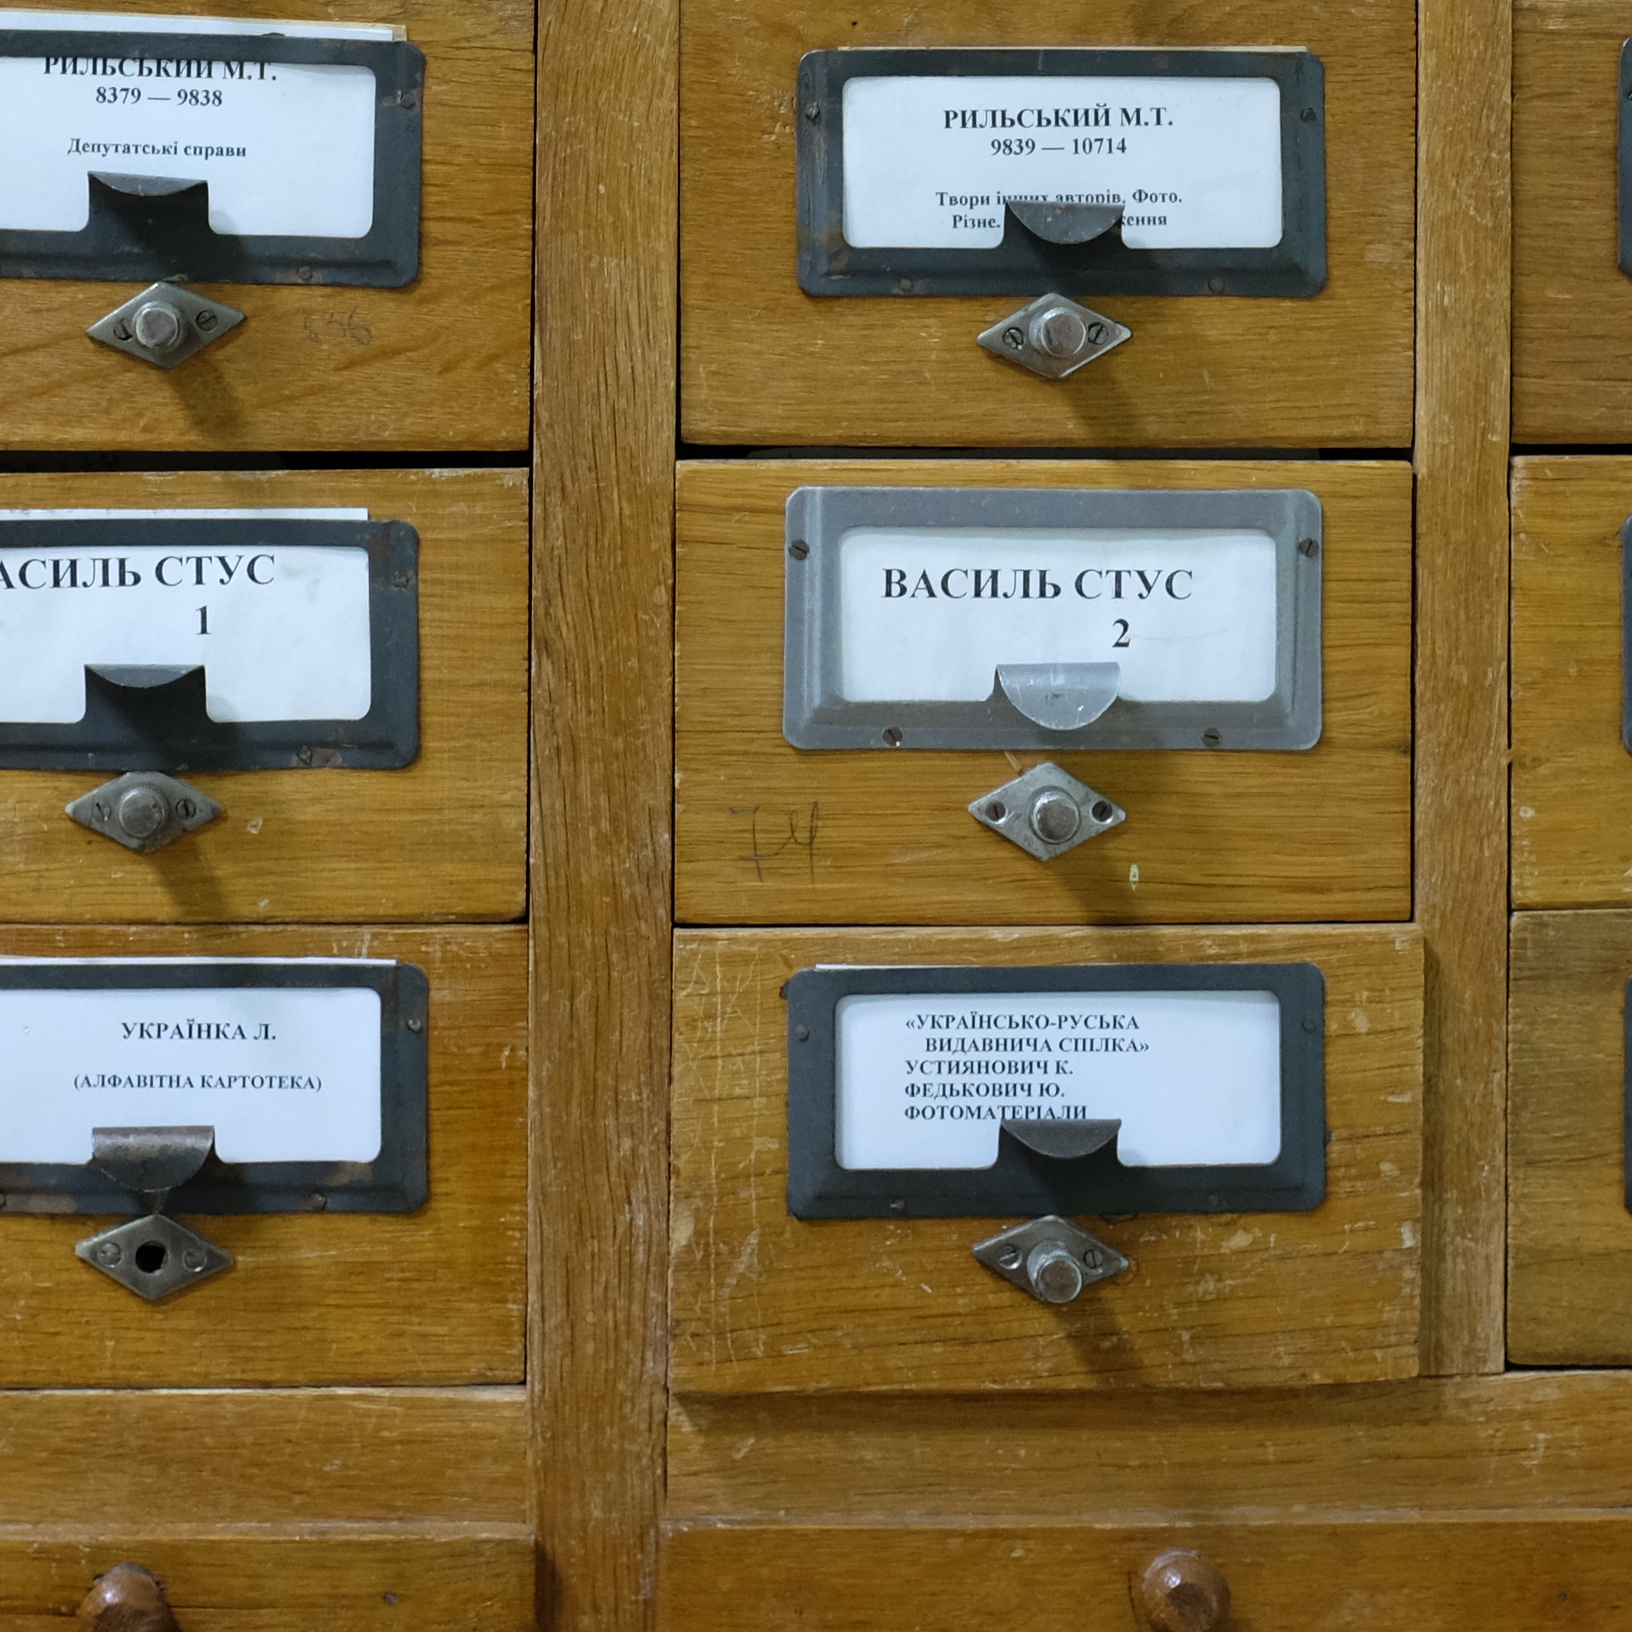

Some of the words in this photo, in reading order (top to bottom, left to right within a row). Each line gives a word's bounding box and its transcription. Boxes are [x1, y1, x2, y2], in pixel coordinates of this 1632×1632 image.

[95, 86, 142, 105] 8379
[176, 88, 223, 107] 9838
[944, 102, 1111, 129] РИЛЬСЬКИЙ
[1119, 107, 1173, 127] М.Т.
[67, 137, 178, 158] Депутатські
[183, 145, 247, 161] справи
[990, 138, 1036, 156] 9839
[1072, 137, 1127, 155] 10714
[935, 191, 990, 210] Твори
[1131, 188, 1183, 204] Фото.
[952, 214, 1001, 229] Різне.
[154, 554, 275, 587] СТУС
[883, 568, 1062, 599] ВАСИЛЬ
[1074, 568, 1193, 600] СТУС
[198, 605, 210, 636] 1
[1112, 618, 1131, 648] 2
[121, 1018, 247, 1040] УКРАЇНКА
[253, 1023, 276, 1041] Л.
[905, 1010, 1140, 1030] «УКРАЇНСЬКО-РУСЬКА
[925, 1037, 1053, 1054] ВИДАВНИЧА
[1058, 1037, 1150, 1053] СПІЛКА»
[905, 1059, 1049, 1075] УСТИЯНОВИЧ
[1055, 1059, 1074, 1075] К.
[73, 1074, 195, 1090] (АЛФАВІТНА
[200, 1074, 322, 1092] КАРТОТЕКА)
[904, 1082, 1032, 1101] ФЕДЬКОВИЧ
[1038, 1082, 1065, 1098] Ю.
